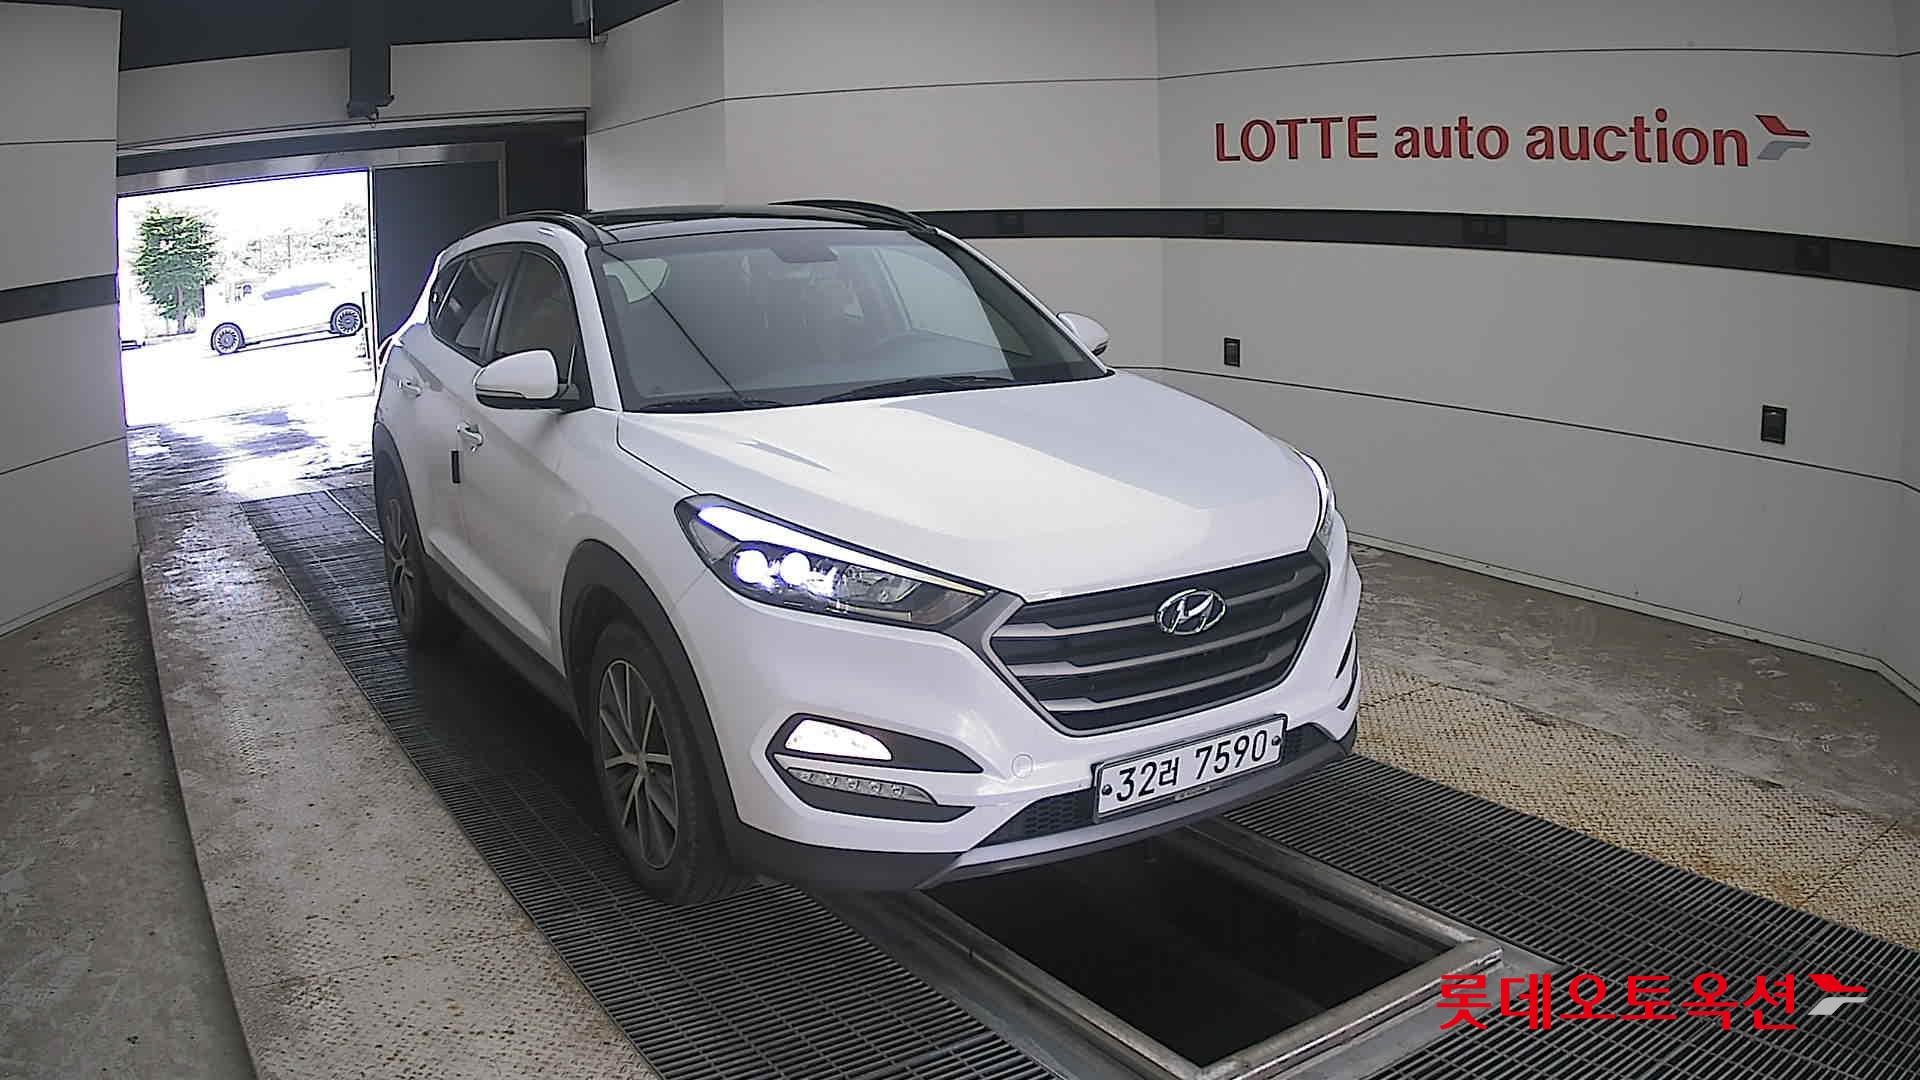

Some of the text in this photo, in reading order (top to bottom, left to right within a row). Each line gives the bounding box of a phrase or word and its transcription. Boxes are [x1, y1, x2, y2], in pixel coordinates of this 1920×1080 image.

[1215, 108, 1749, 167] LOTTE auto auction
[1116, 729, 1267, 802] 32러 7590
